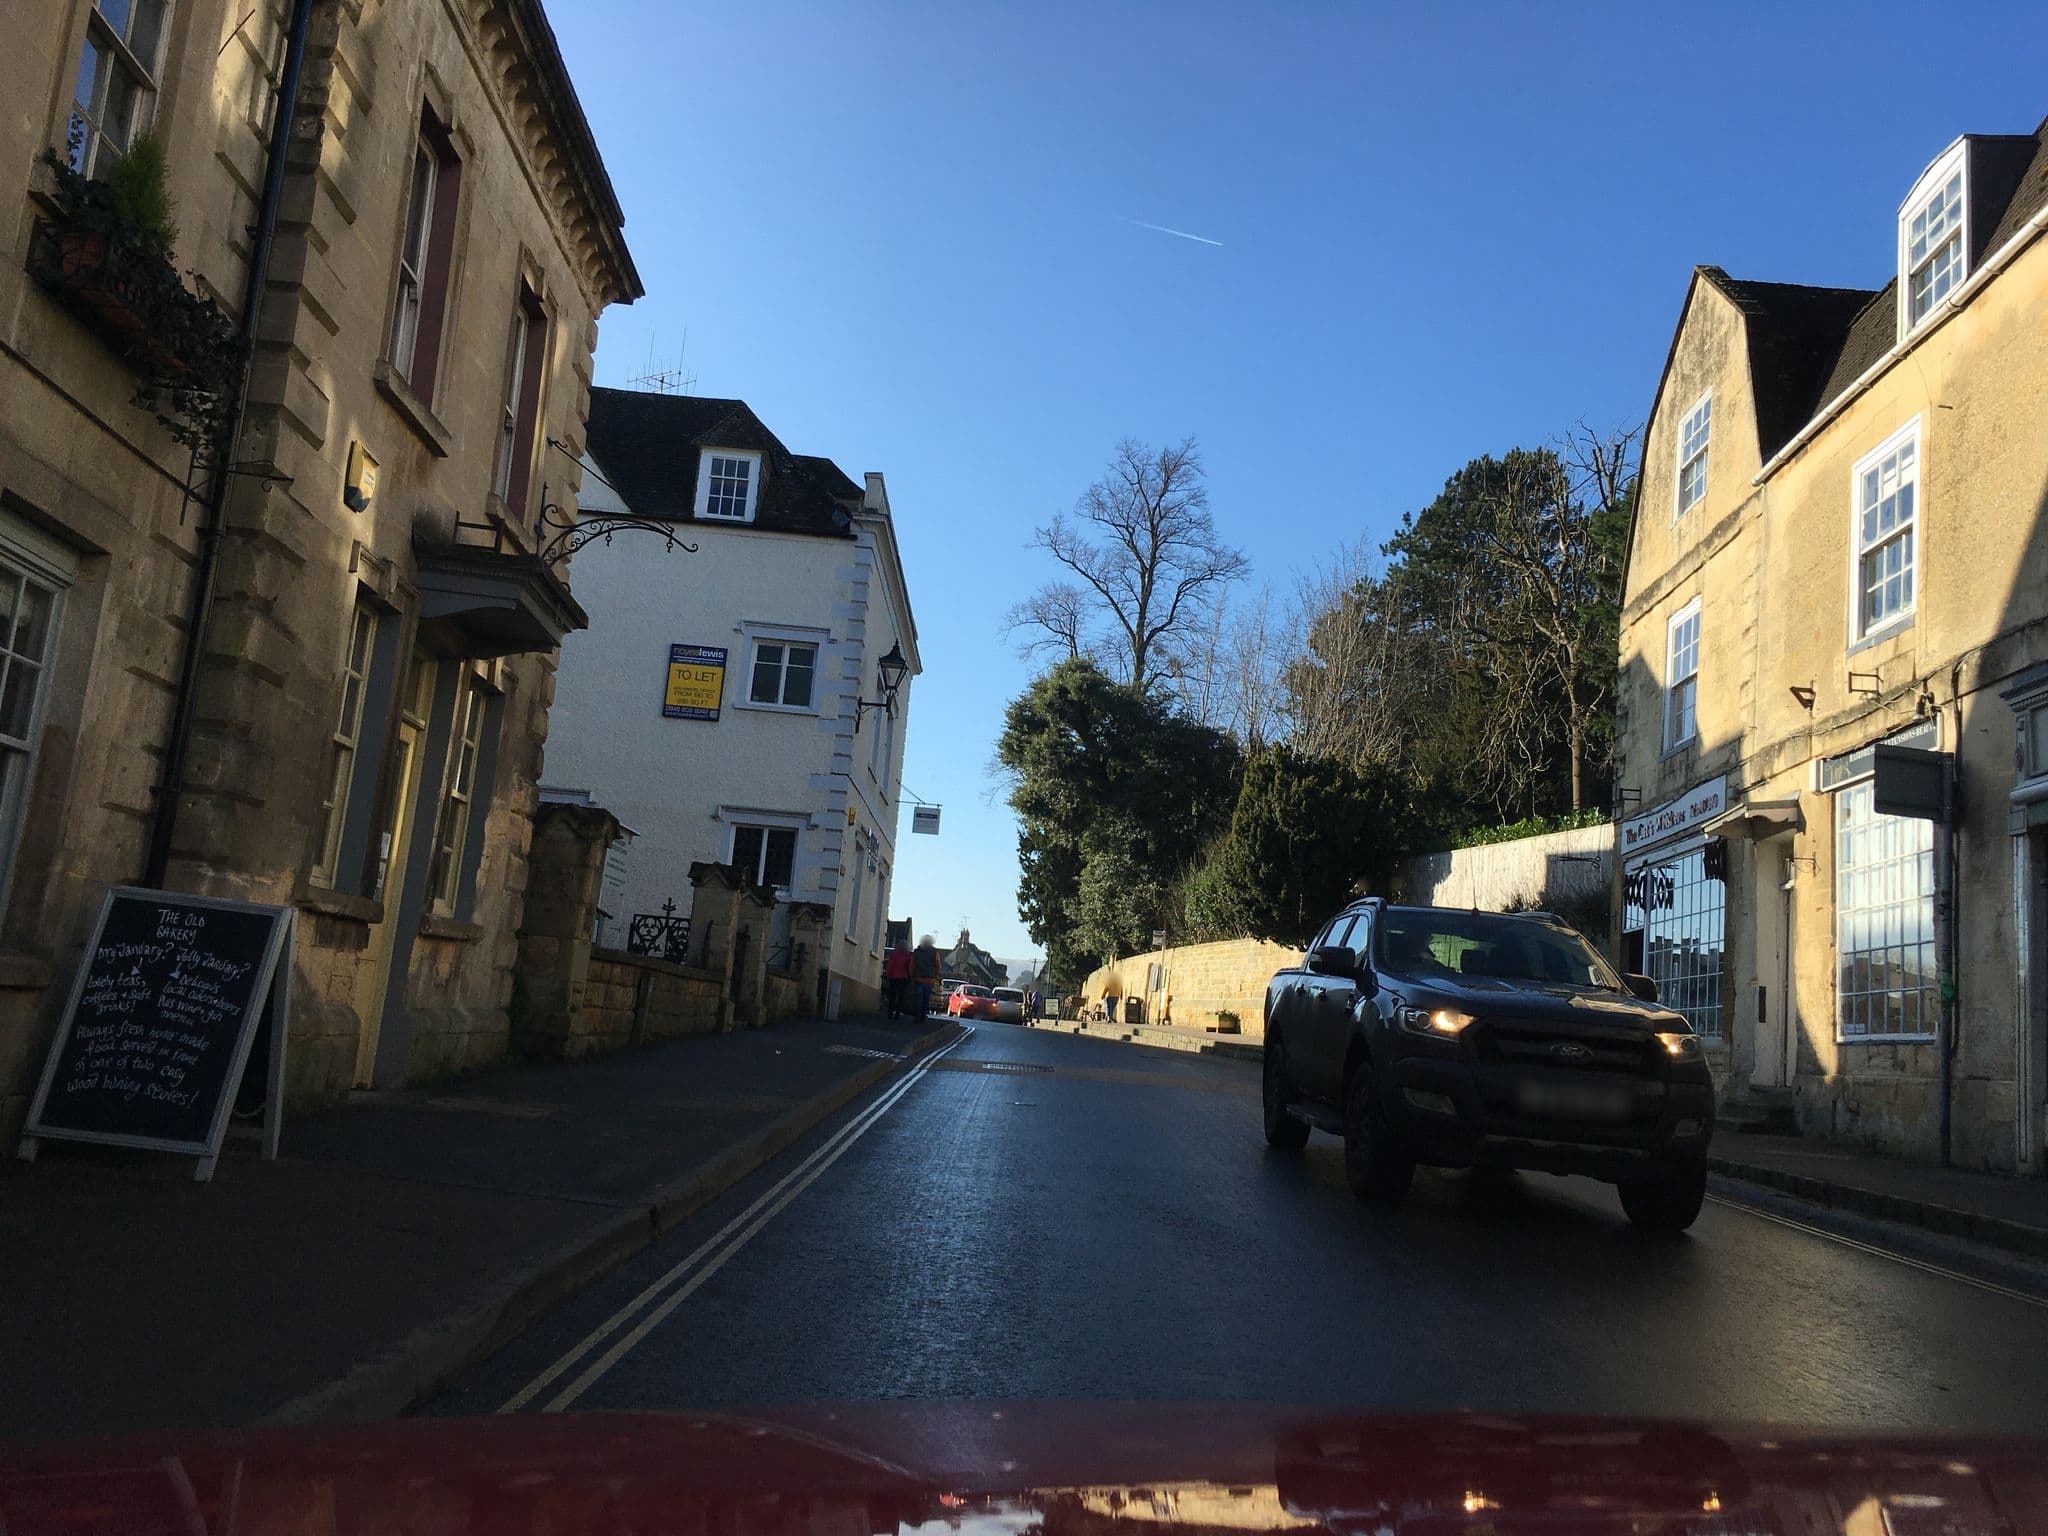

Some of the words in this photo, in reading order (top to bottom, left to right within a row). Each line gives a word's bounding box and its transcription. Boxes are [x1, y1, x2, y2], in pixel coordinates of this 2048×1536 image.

[676, 669, 692, 681] TO
[695, 671, 717, 683] LET
[157, 909, 180, 924] THE
[185, 912, 205, 927] OLD
[156, 926, 197, 945] BAKERY
[117, 942, 174, 963] January?
[200, 951, 251, 982] January?
[76, 1024, 115, 1042] Always
[115, 1020, 144, 1038] fresh
[84, 1038, 115, 1056] food
[120, 1040, 158, 1054] served
[158, 1046, 171, 1056] in
[73, 1056, 86, 1072] of
[89, 1057, 113, 1069] one
[116, 1055, 129, 1069] of
[131, 1057, 155, 1071] two
[67, 1071, 99, 1092] wood
